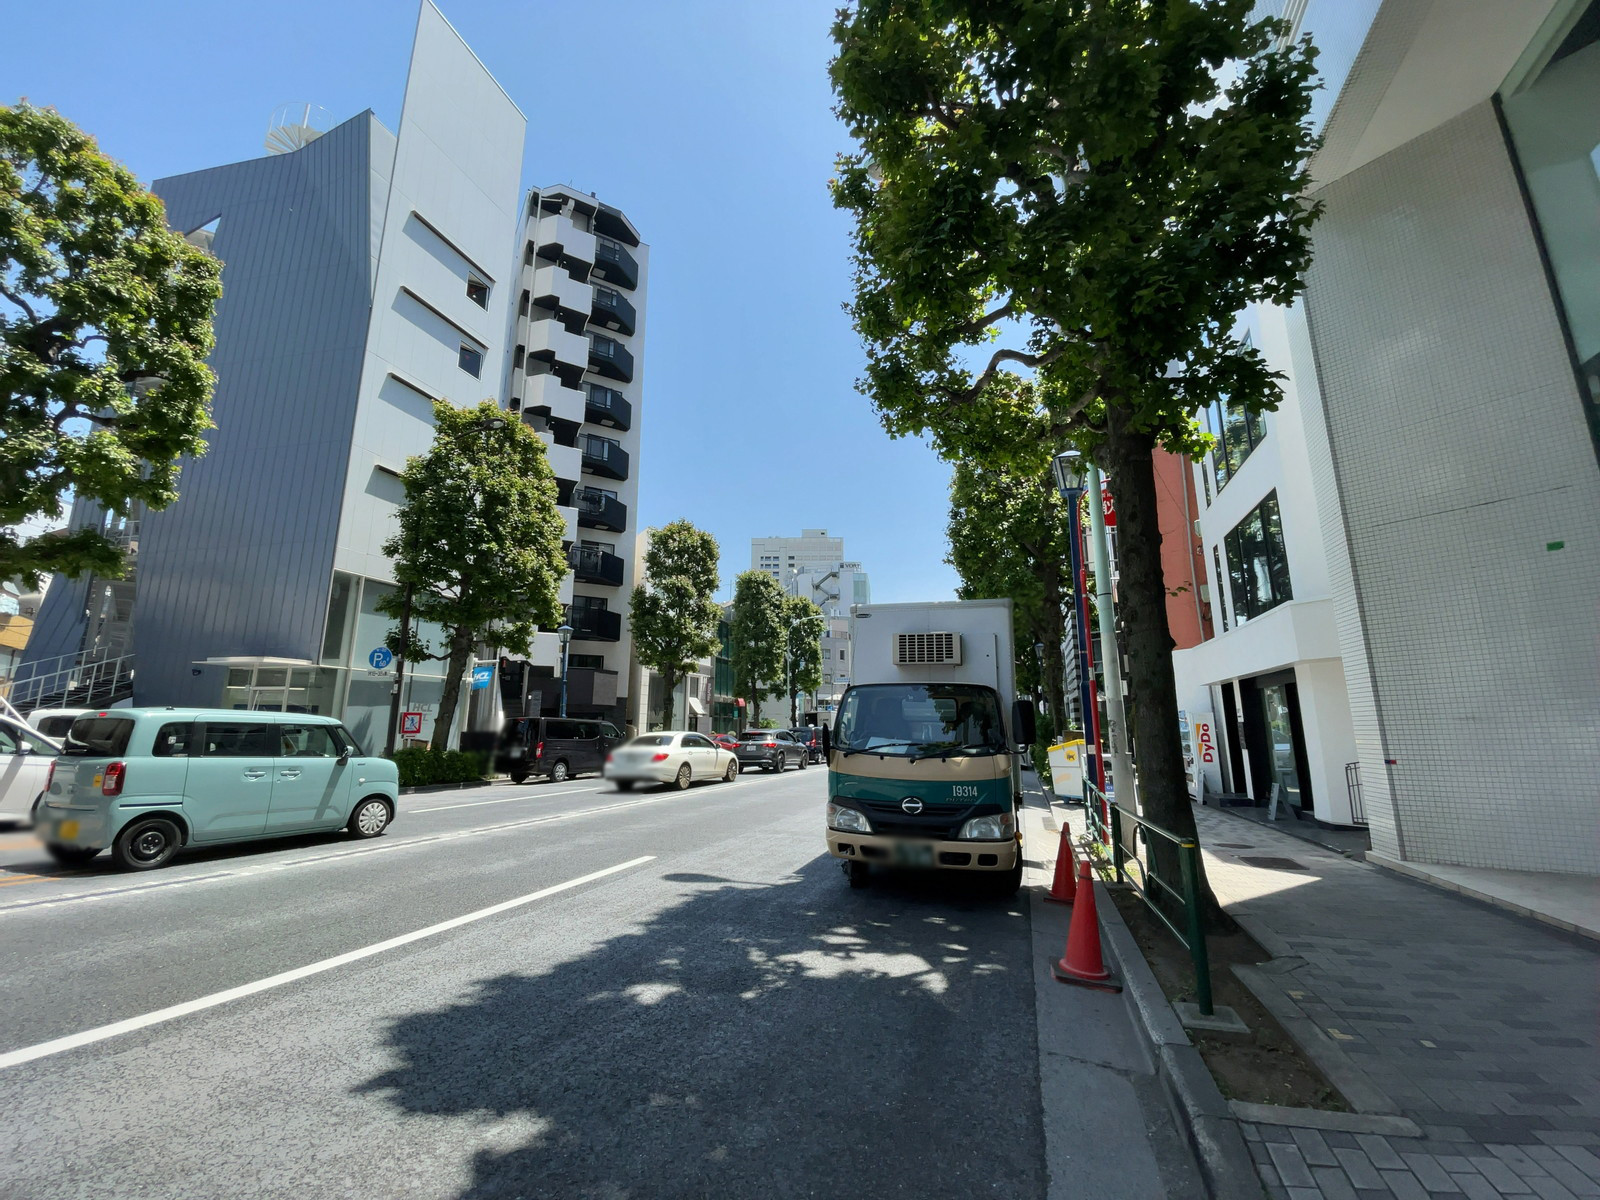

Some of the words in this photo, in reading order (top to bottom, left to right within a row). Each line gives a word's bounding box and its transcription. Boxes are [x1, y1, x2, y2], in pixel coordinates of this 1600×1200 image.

[373, 653, 383, 667] P
[474, 671, 489, 680] HCL
[1201, 723, 1215, 763] DyDo
